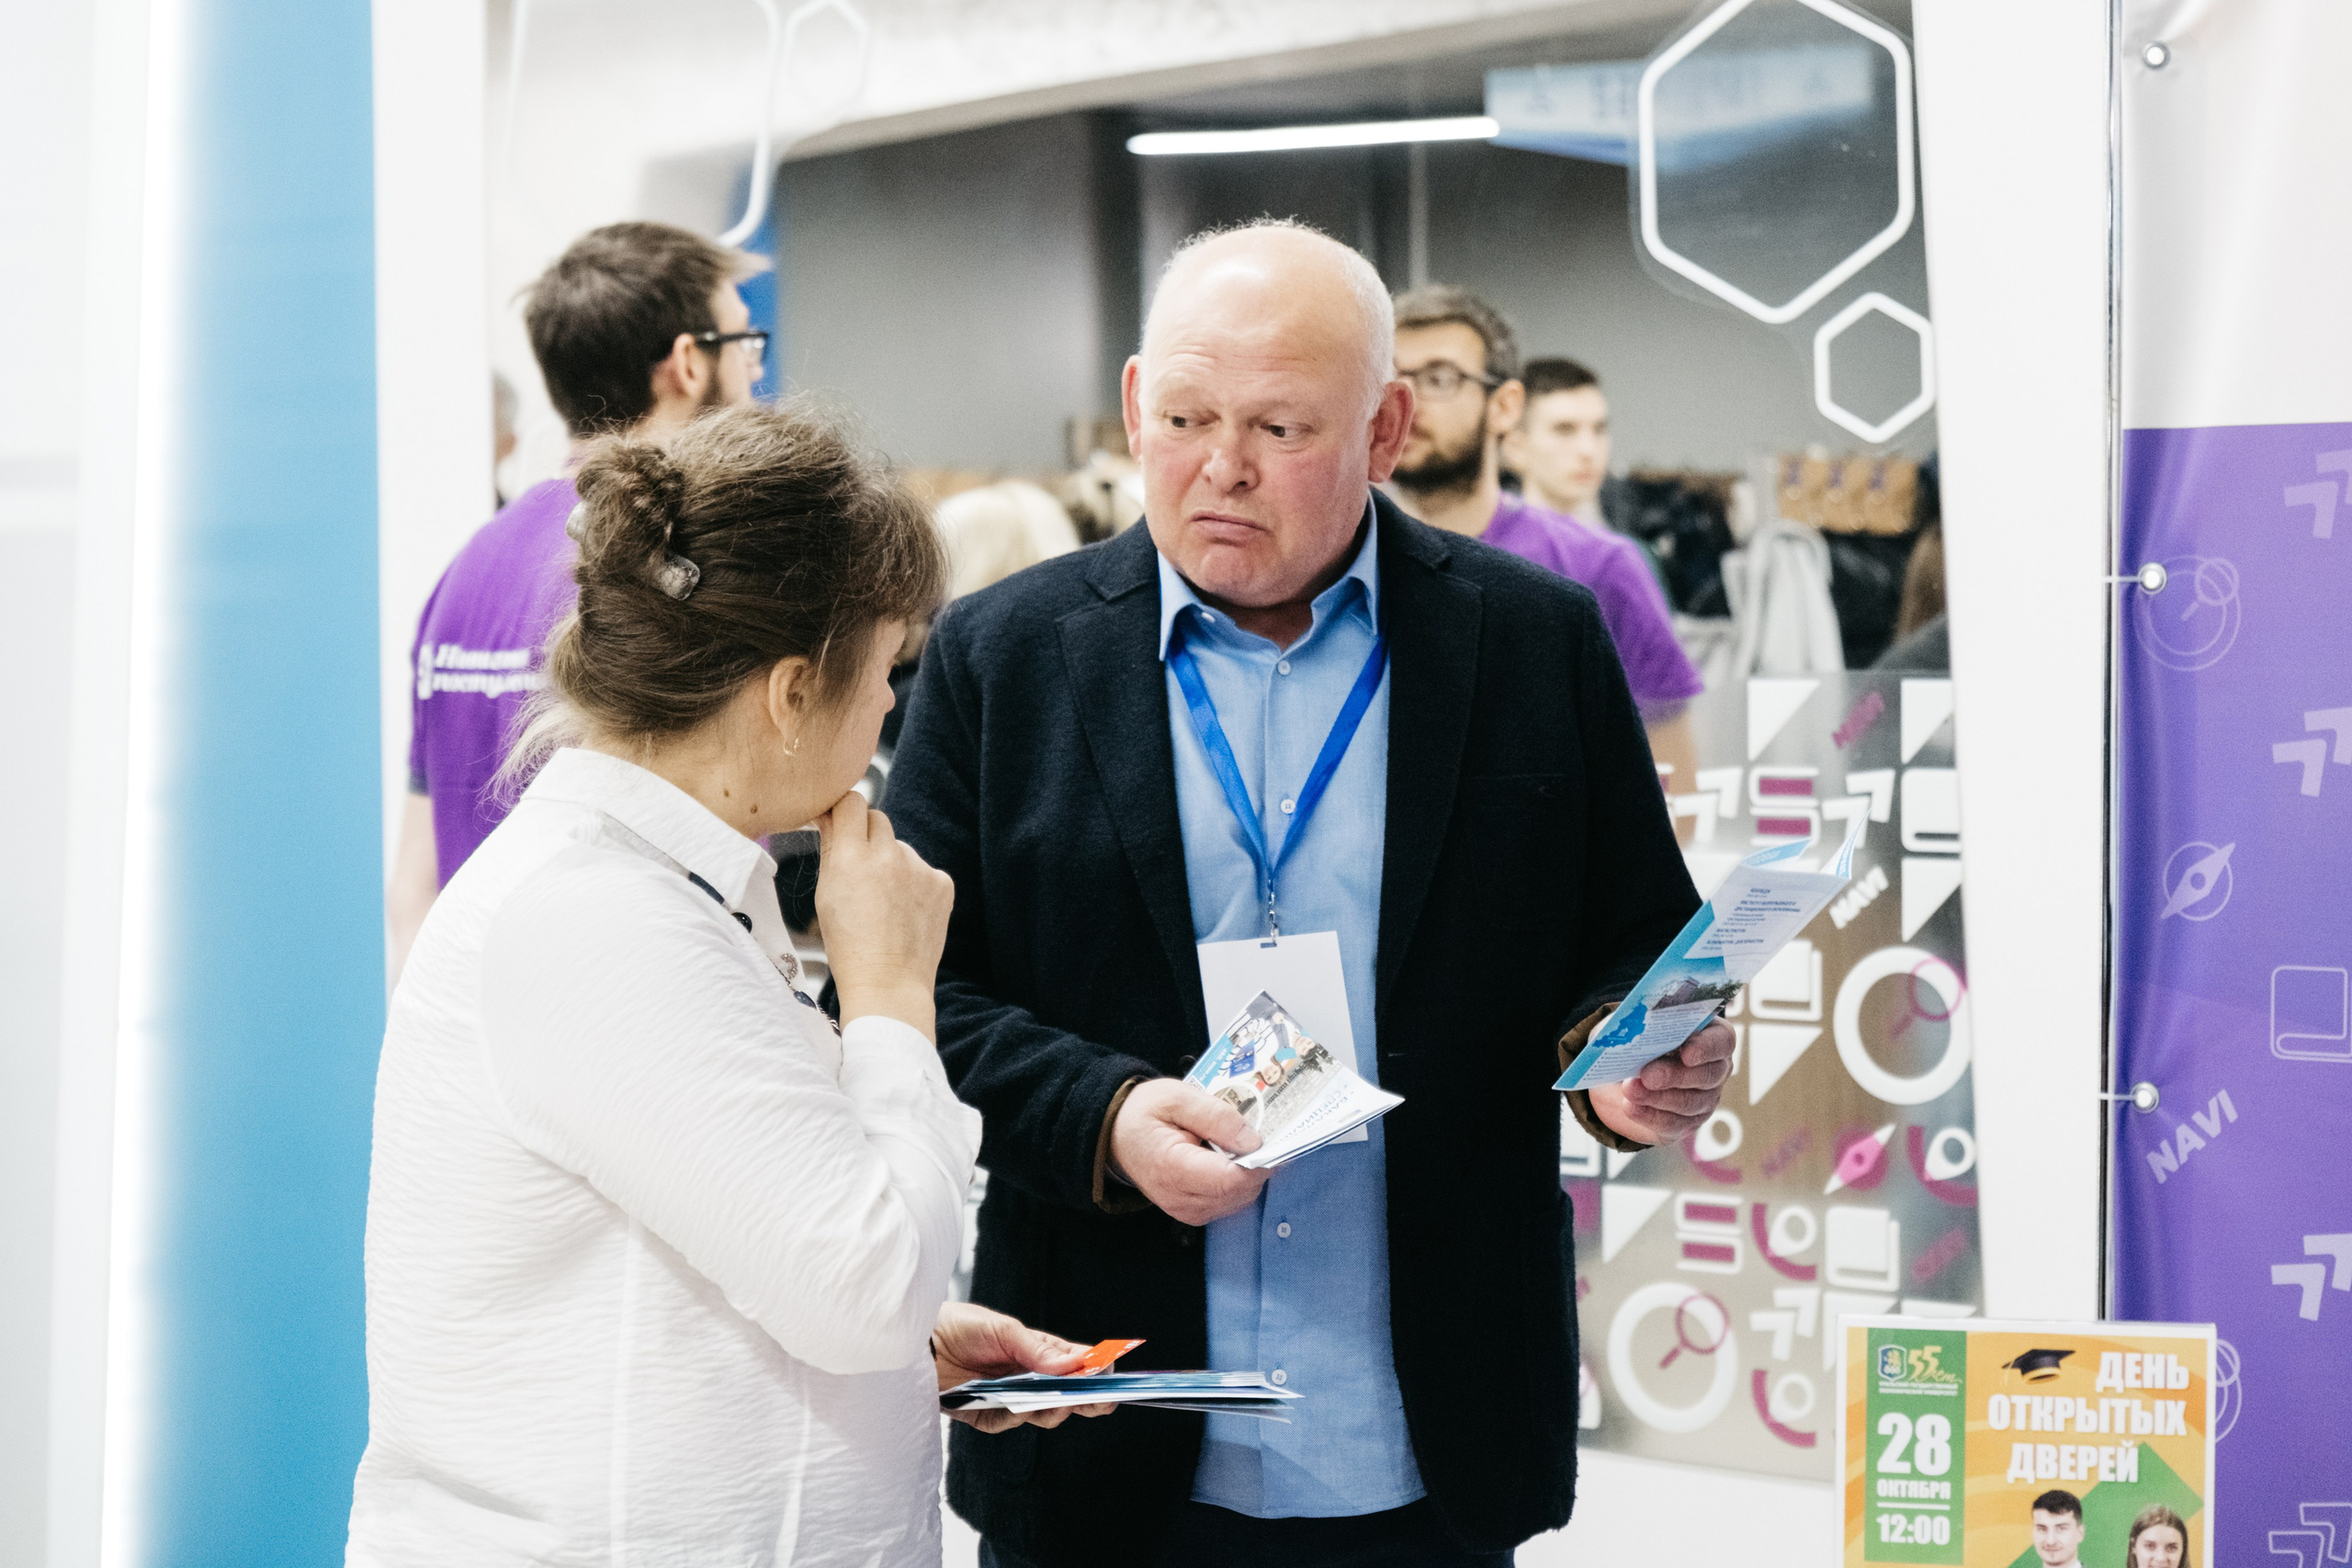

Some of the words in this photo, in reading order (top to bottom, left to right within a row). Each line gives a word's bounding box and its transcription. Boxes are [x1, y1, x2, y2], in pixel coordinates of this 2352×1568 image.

[2146, 1089, 2238, 1184] NAVI
[1908, 1346, 1942, 1382] 55
[2096, 1352, 2189, 1393] ДЕНЬ
[1988, 1393, 2187, 1436] ОТКРЫТЫХ
[1876, 1412, 1951, 1475] 28
[2007, 1439, 2139, 1483] ДВЕРЕЙ
[1876, 1479, 1951, 1500] ОКТЯБРЯ
[1876, 1514, 1951, 1545] 12:00
